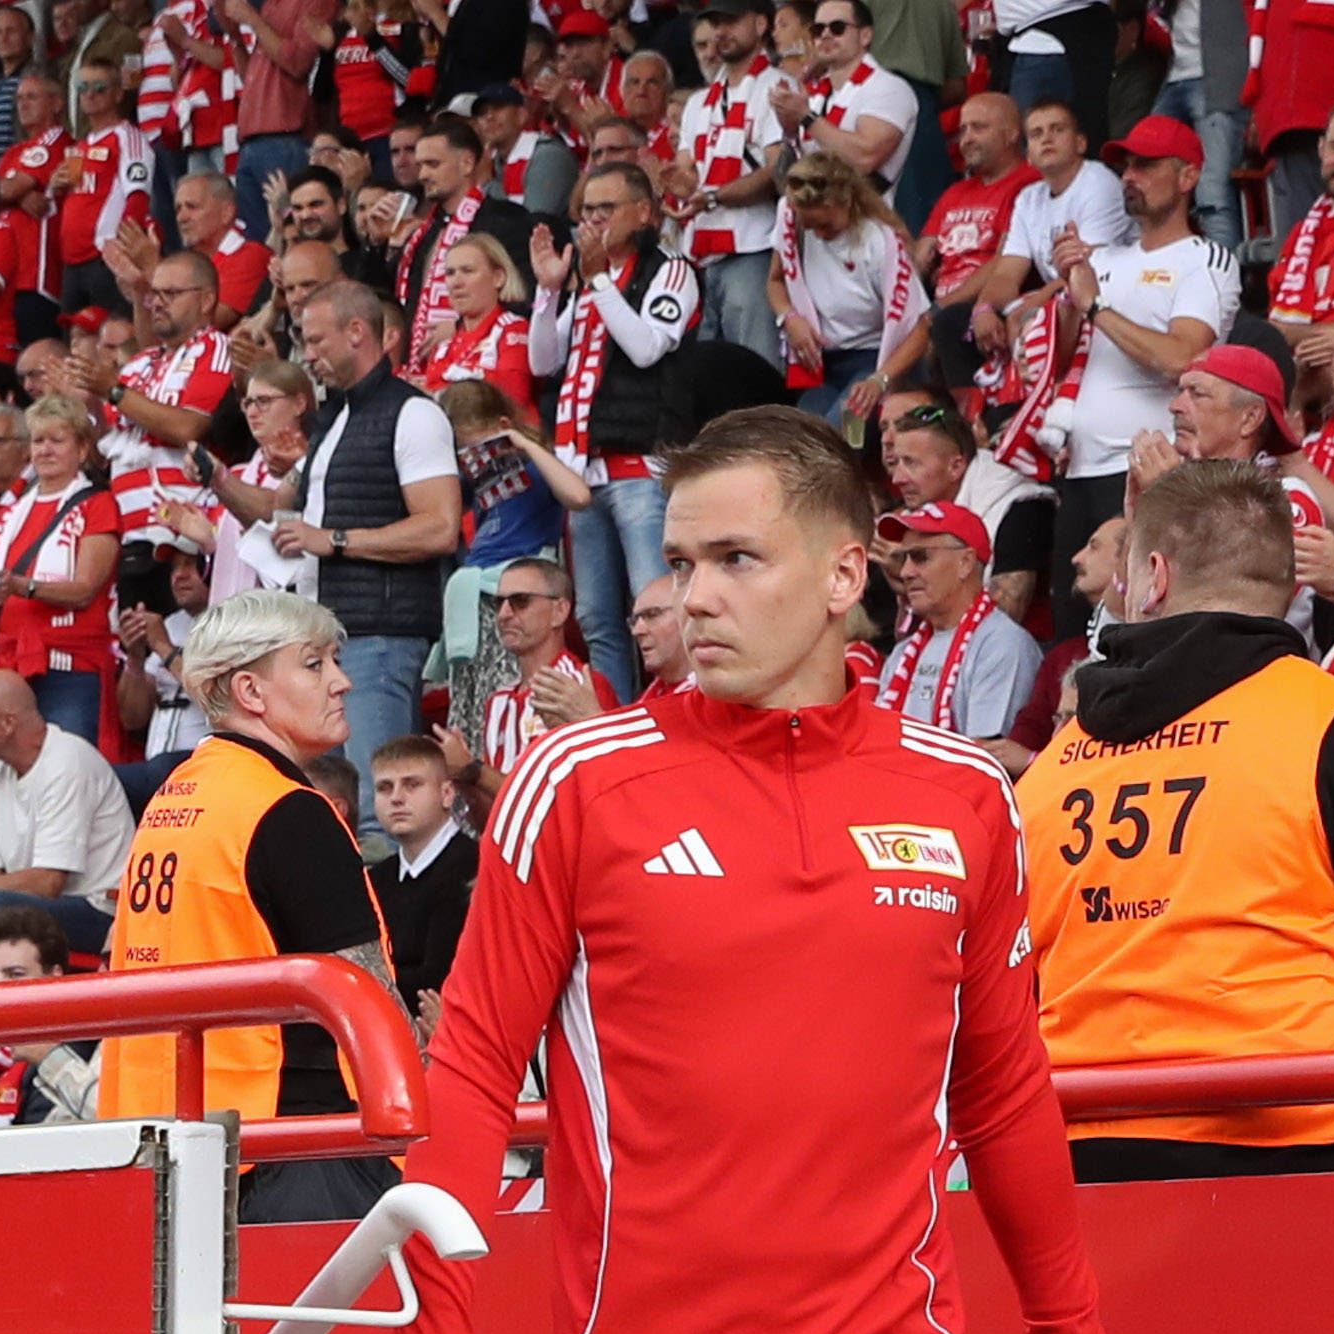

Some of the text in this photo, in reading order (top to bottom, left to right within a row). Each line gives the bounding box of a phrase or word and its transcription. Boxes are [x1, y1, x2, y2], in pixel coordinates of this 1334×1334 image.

[650, 299, 679, 320] JD
[141, 807, 205, 830] HERHEIT
[1059, 776, 1207, 866] 357
[127, 851, 178, 915] 88
[898, 883, 958, 915] raisin
